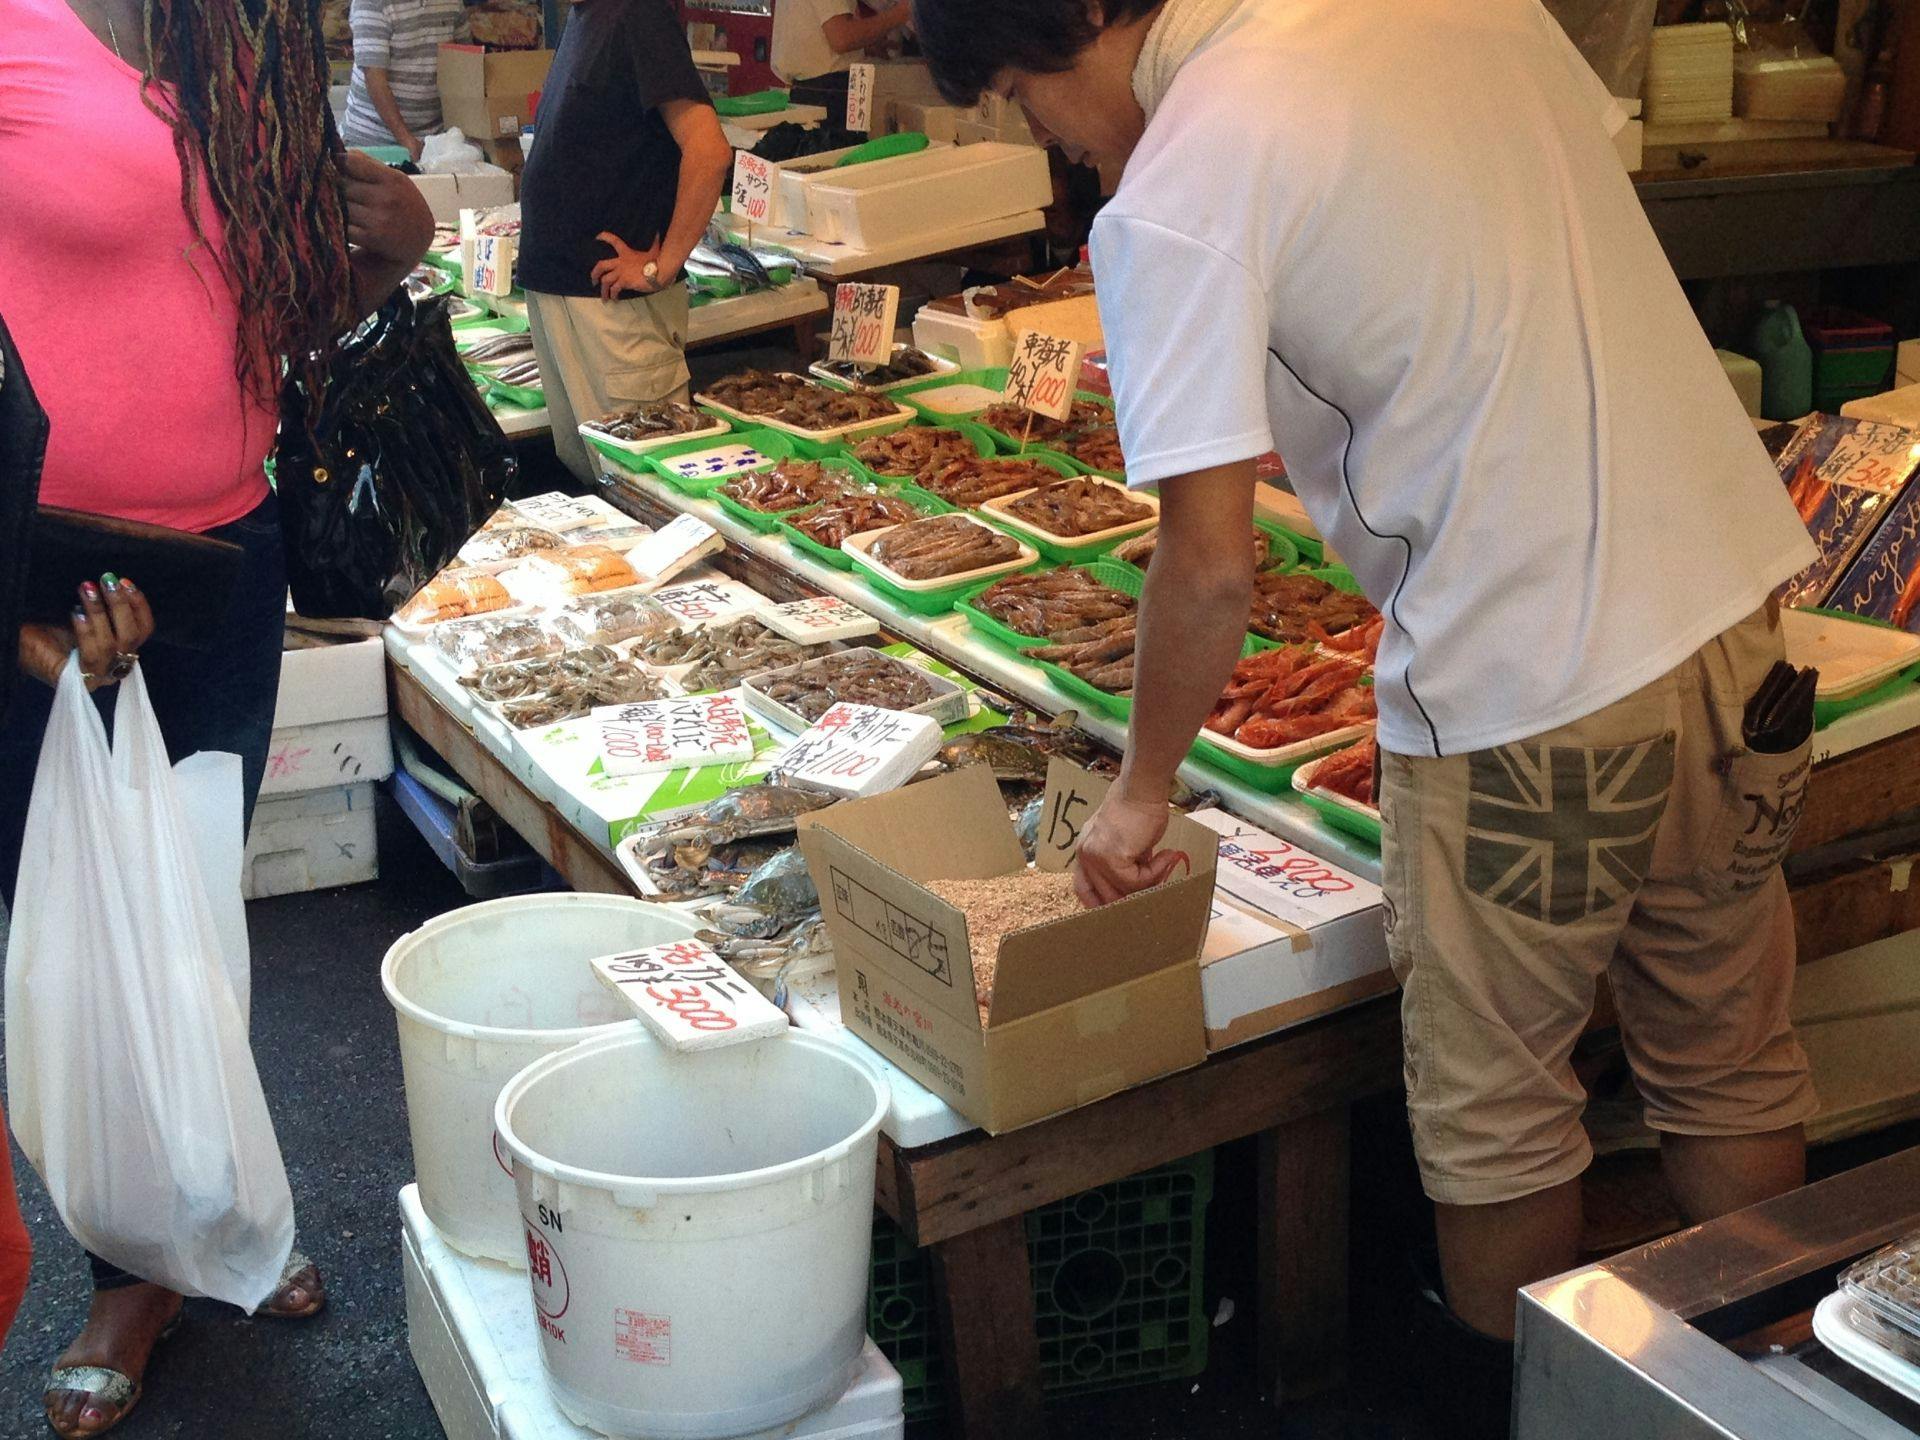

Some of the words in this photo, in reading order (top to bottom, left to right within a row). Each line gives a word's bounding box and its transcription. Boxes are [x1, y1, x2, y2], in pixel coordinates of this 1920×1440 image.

[1023, 332, 1071, 373] 車海老
[656, 943, 747, 1005] 活カニ
[538, 1203, 563, 1234] SN
